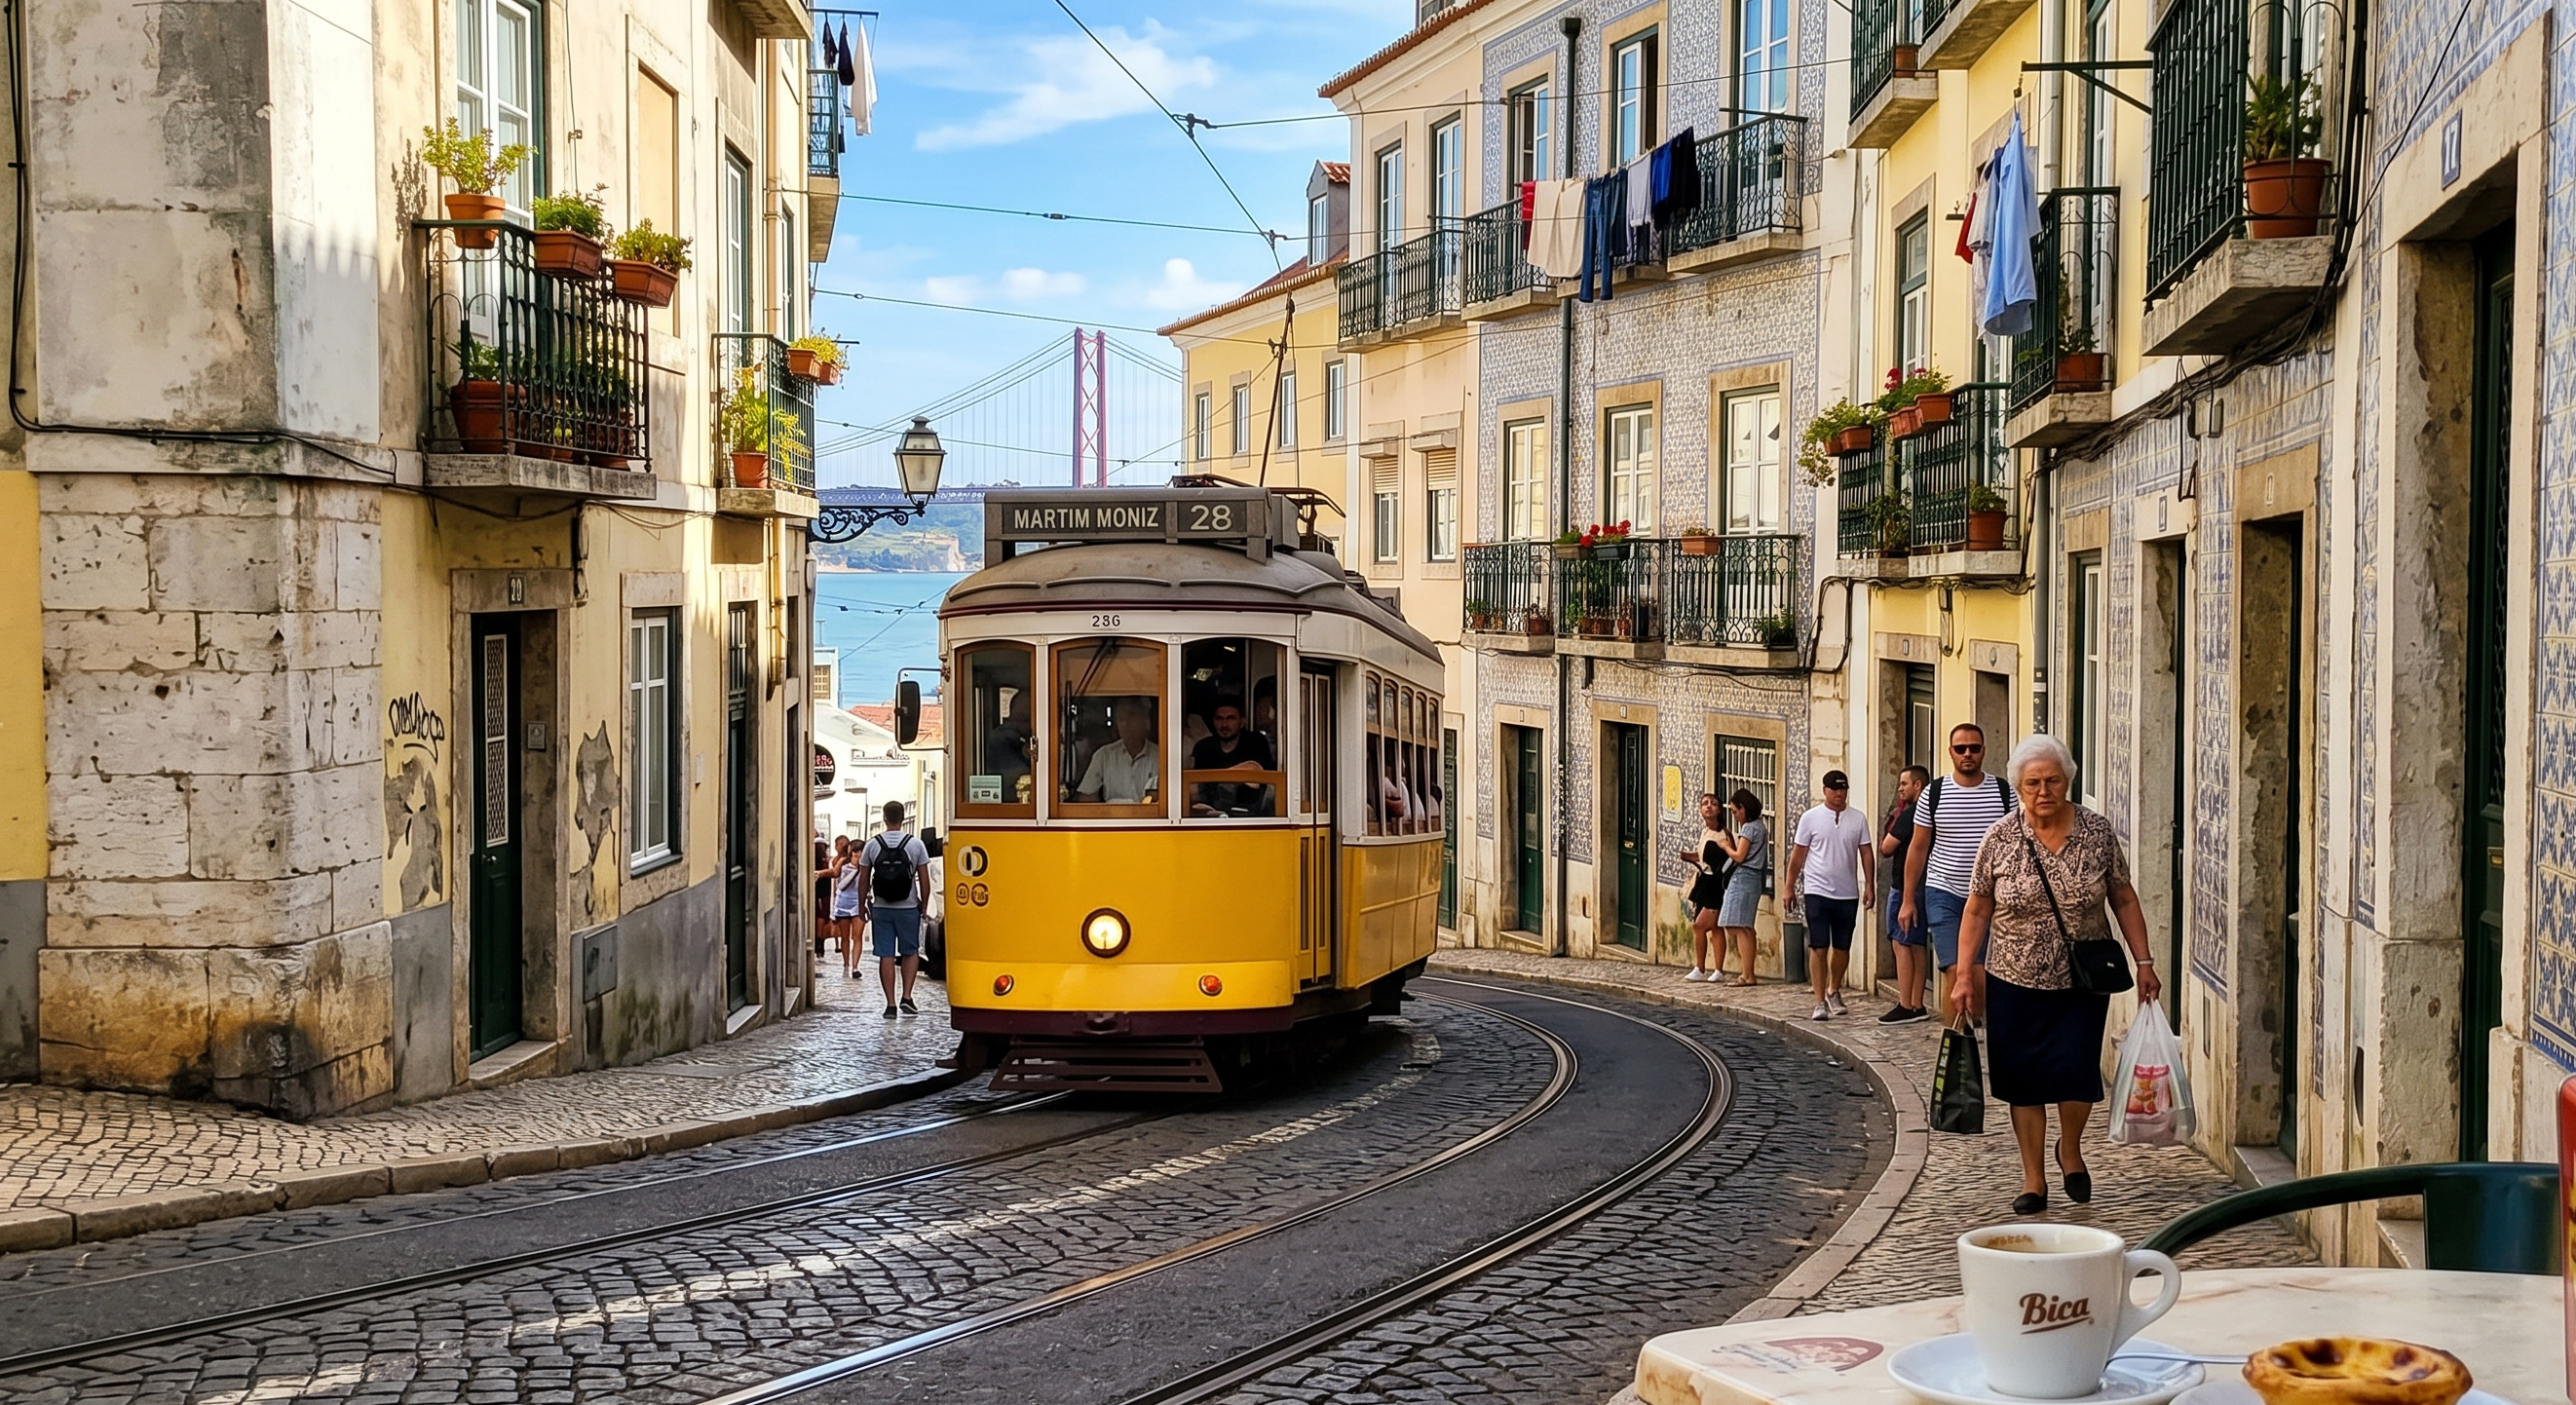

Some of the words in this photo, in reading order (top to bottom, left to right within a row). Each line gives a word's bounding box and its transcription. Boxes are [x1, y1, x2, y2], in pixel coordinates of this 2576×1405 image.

[2444, 119, 2458, 176] 17
[1014, 508, 1090, 529] MARTIM
[1096, 506, 1159, 528] MONIZ
[1190, 504, 1232, 531] 28
[2019, 1292, 2091, 1326] Bica
